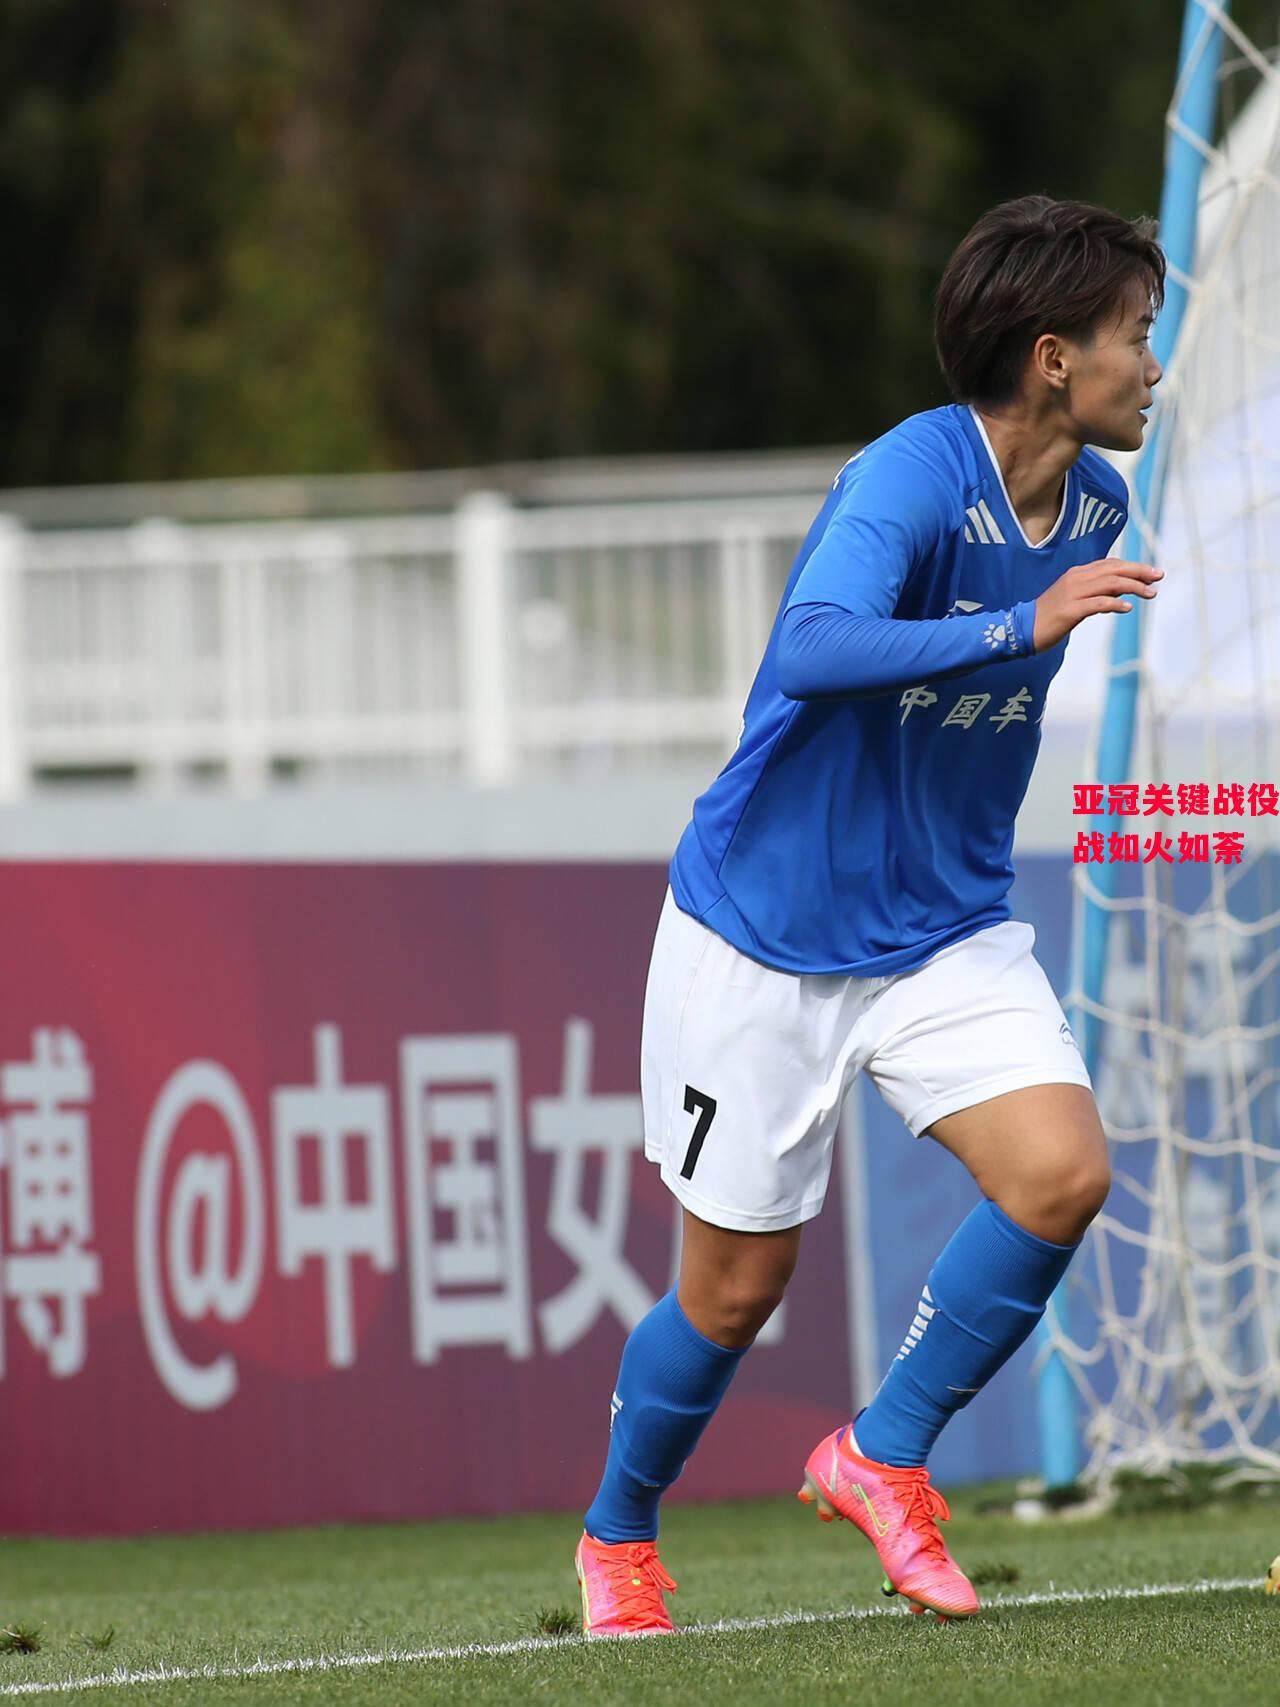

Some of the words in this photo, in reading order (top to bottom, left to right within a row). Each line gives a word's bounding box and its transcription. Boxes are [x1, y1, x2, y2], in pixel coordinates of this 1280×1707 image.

[899, 684, 1047, 734] 中国车
[680, 1084, 718, 1181] 7
[0, 1016, 785, 1413] 博@中国女
